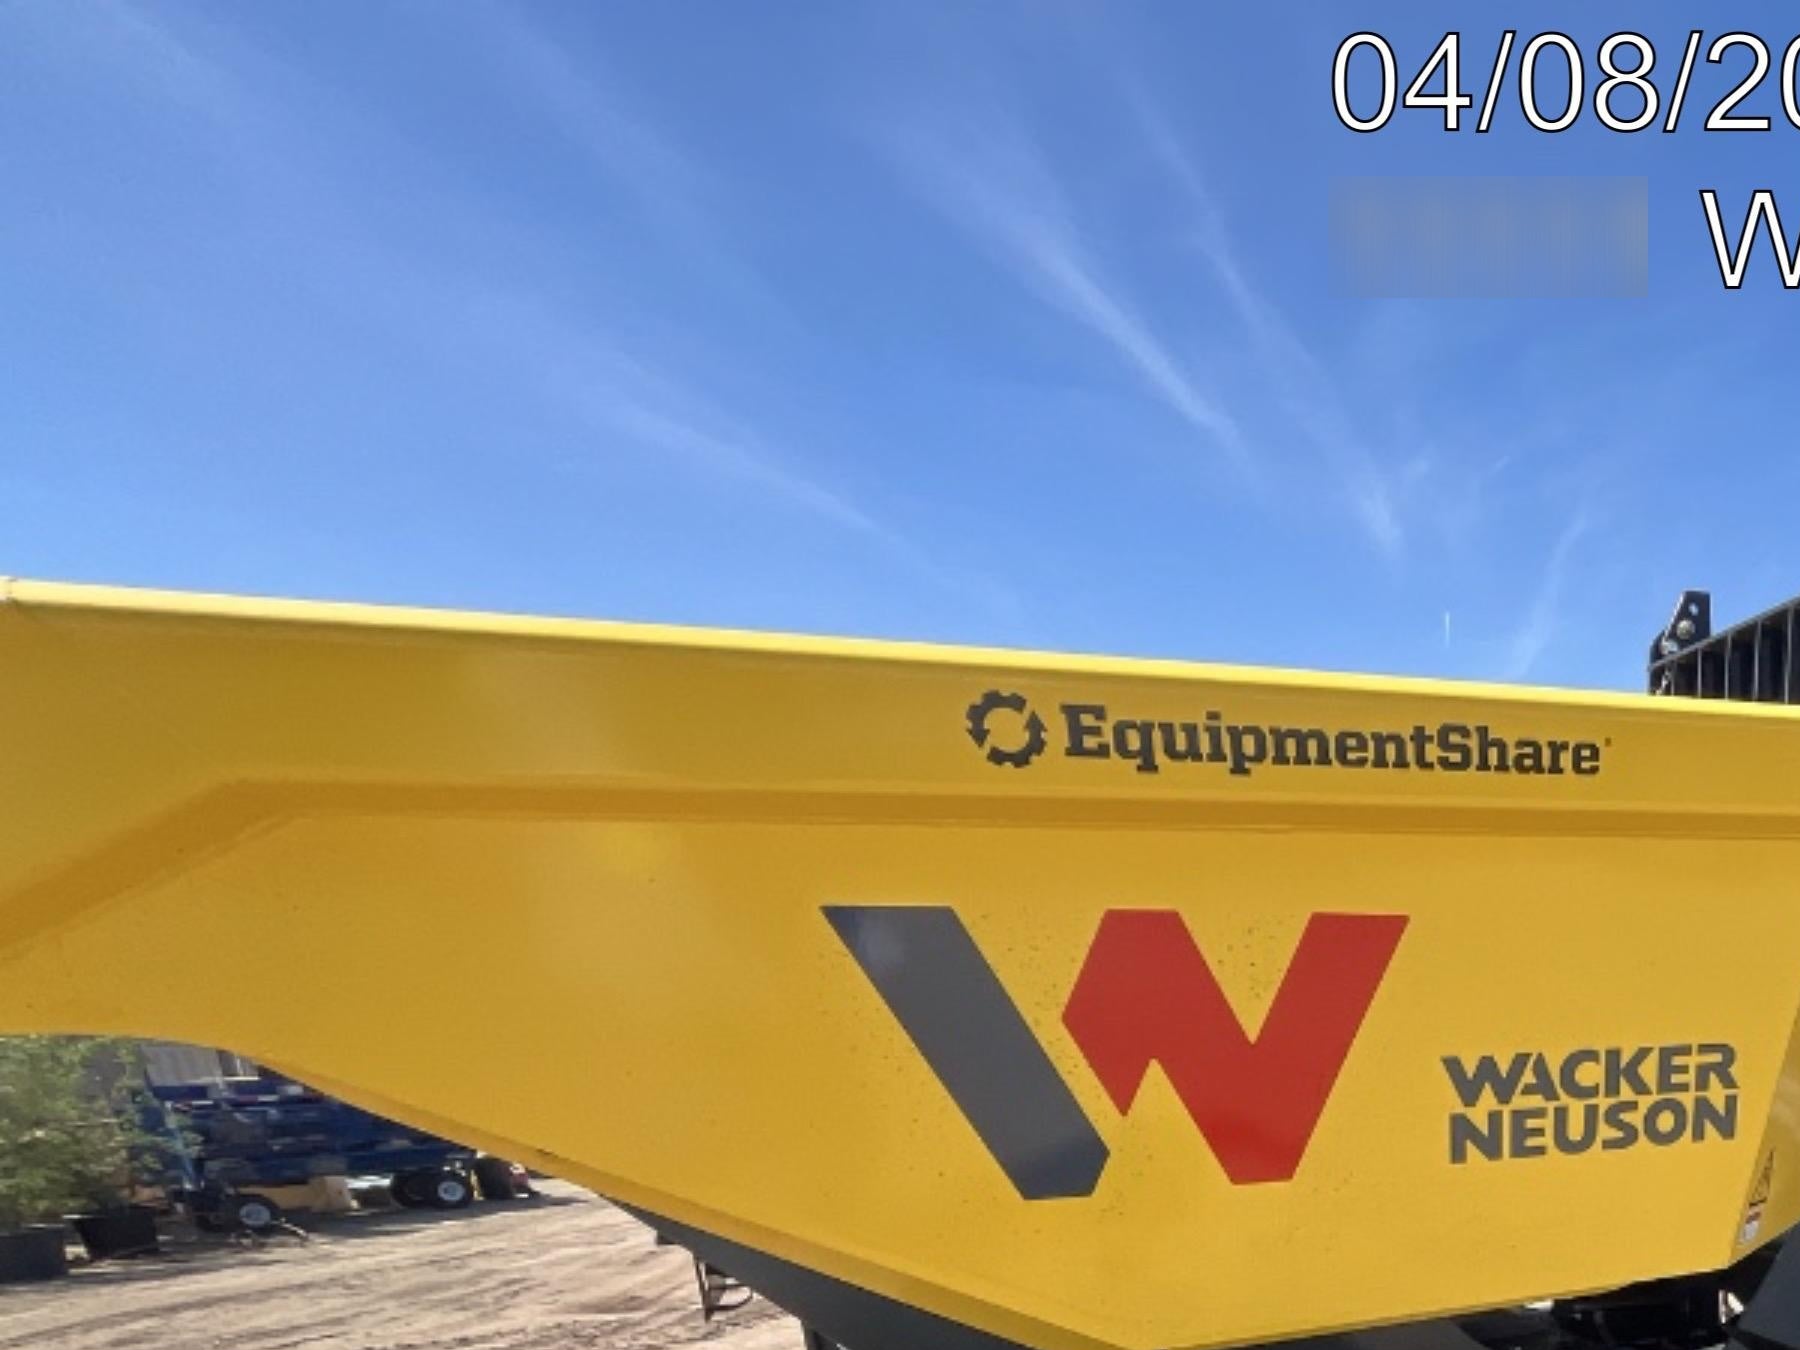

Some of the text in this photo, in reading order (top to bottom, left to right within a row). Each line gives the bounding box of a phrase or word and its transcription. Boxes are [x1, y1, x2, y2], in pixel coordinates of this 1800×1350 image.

[1060, 702, 1601, 777] EquipmentShare
[1440, 1042, 1740, 1108] WACKER
[1448, 1093, 1738, 1165] NEUSON
